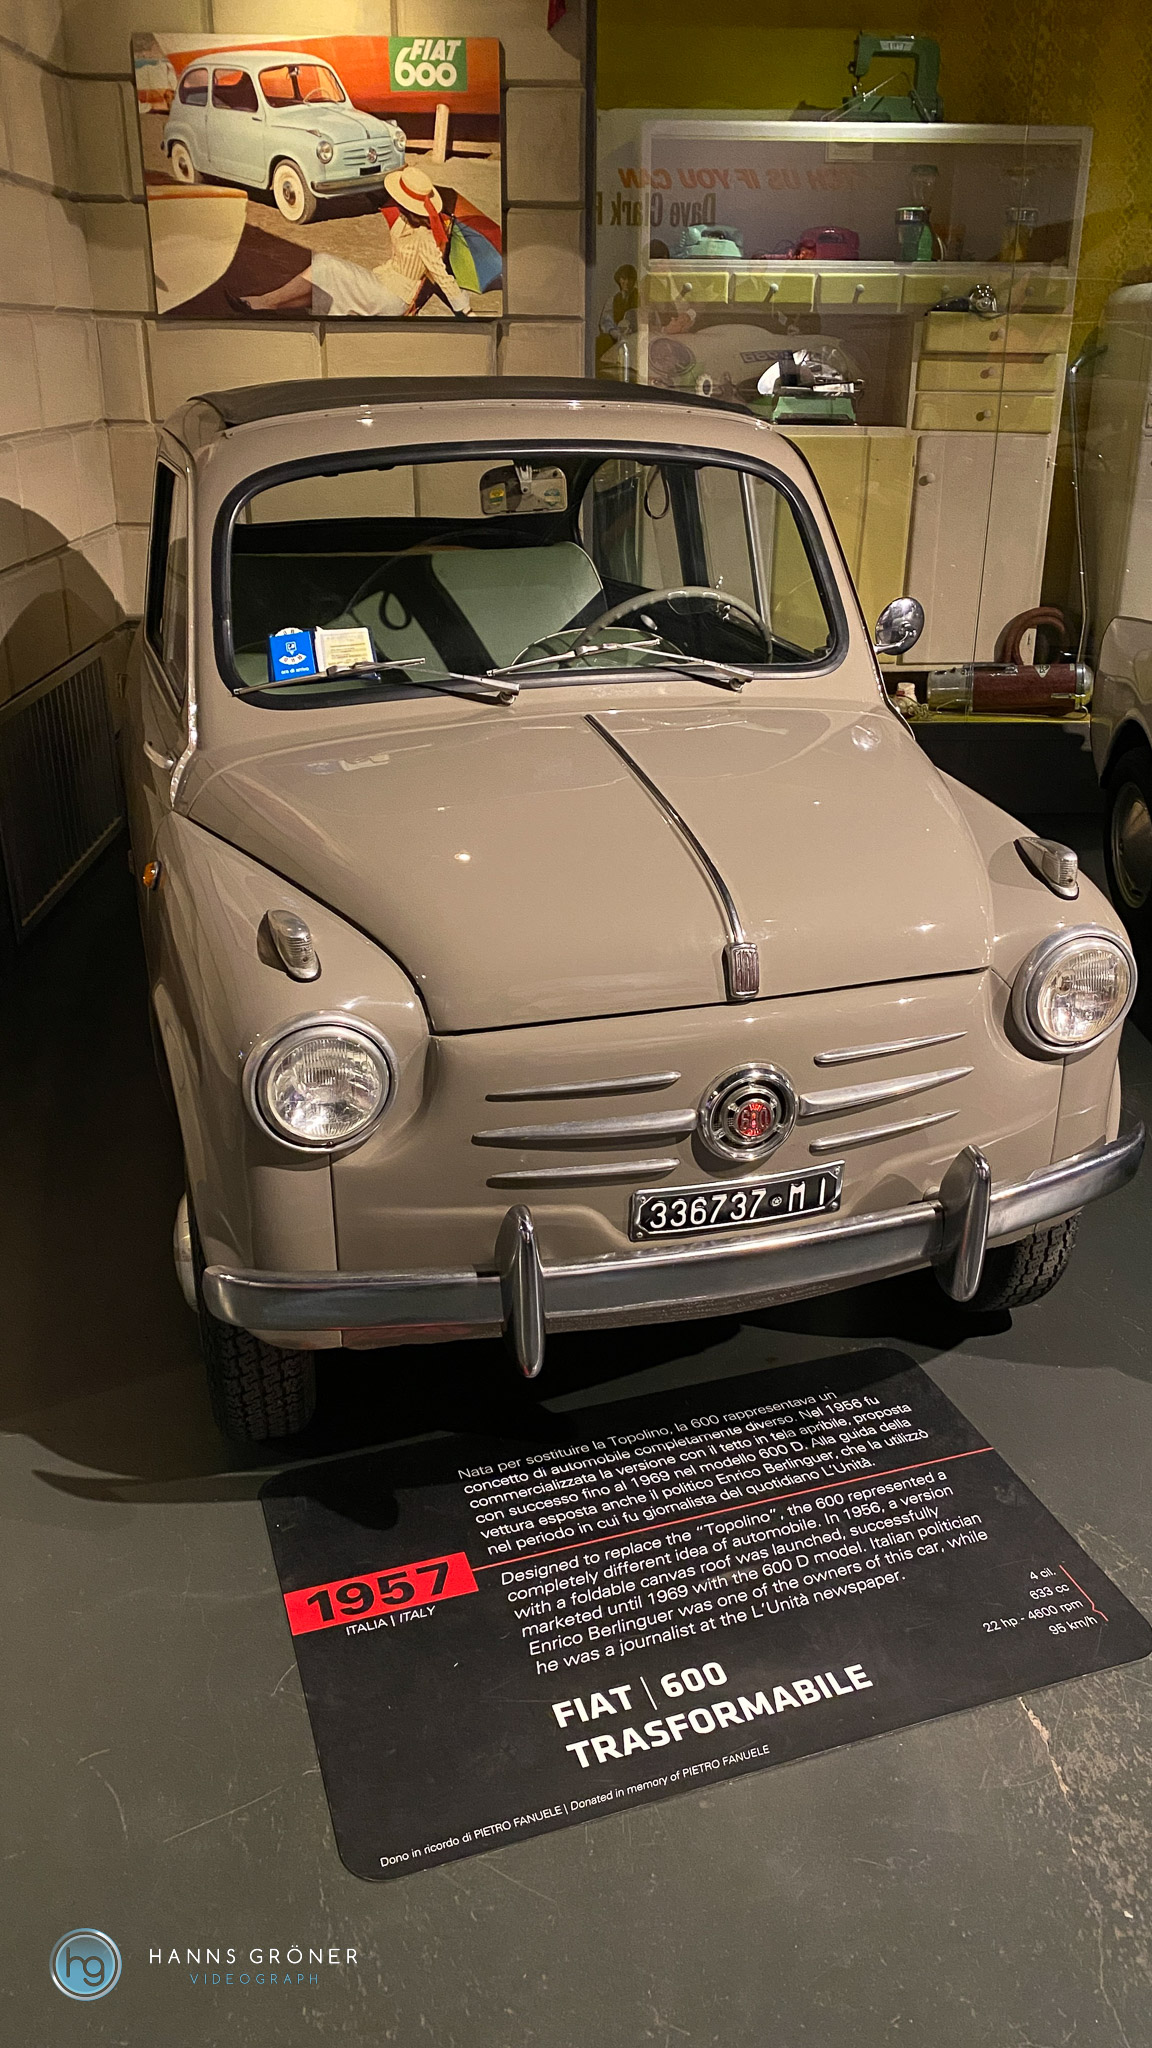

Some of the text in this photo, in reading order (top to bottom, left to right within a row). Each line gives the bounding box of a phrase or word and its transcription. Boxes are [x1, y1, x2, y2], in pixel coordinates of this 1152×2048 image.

[395, 47, 457, 87] 600
[409, 39, 462, 61] FIAT
[649, 1188, 766, 1230] 336737
[457, 1391, 838, 1480] Nata per sostituire la Topolino, la 600 rappresentava un
[463, 1396, 881, 1494] concetto di automobile completamente diverso. Nel 1956 fu
[469, 1404, 913, 1509] commercializzata la versione con il tetto in tela apribile, proposta
[475, 1418, 912, 1524] con successo fino al 1969 nel modello 600 D. Alla guida della
[479, 1428, 929, 1539] vettura esposta anche il politico Enrico Berlinguer, che la utilizzò
[487, 1539, 513, 1556] nel
[515, 1526, 575, 1551] periodo
[578, 1523, 594, 1534] in
[596, 1514, 621, 1529] cui
[621, 1511, 640, 1524] fu
[642, 1494, 718, 1521] giornalista
[719, 1486, 744, 1501] del
[745, 1470, 820, 1496] quotidiano
[501, 1555, 580, 1586] Designed
[582, 1553, 601, 1566] to
[604, 1538, 662, 1561] replace
[664, 1531, 692, 1546] the
[786, 1503, 813, 1517] the
[814, 1493, 845, 1510] 600
[847, 1471, 936, 1503] represented
[937, 1471, 948, 1481] a
[507, 1486, 954, 1603] completely different idea of automobile. In 1956, a version
[513, 1506, 939, 1620] with a foldable canvas roof was launched, successfully
[521, 1514, 983, 1638] marketed until 1969 with the 600 D model. Italian politician
[1029, 1567, 1057, 1580] 4 cil.
[307, 1561, 449, 1622] 1957
[345, 1605, 436, 1636] ITALIA ITALY
[528, 1530, 989, 1656] Enrico Berlinguer was one of the owners of this car, while
[535, 1659, 559, 1675] he
[562, 1649, 601, 1667] was
[604, 1645, 616, 1657] a
[619, 1622, 697, 1657] journalist
[699, 1617, 718, 1632] at
[718, 1611, 748, 1627] the
[812, 1570, 906, 1603] newspaper.
[982, 1600, 1084, 1633] 22 hp 4600 rpm
[1029, 1584, 1070, 1600] 633 cc
[1048, 1615, 1098, 1635] 95 km/h
[551, 1661, 729, 1729] FIAT 600
[565, 1663, 874, 1769] TRASFORMABILE
[379, 1744, 771, 1868] Dono in ricordo di PIETRO FANUELE Donated in memory of PIETRO FANUELE
